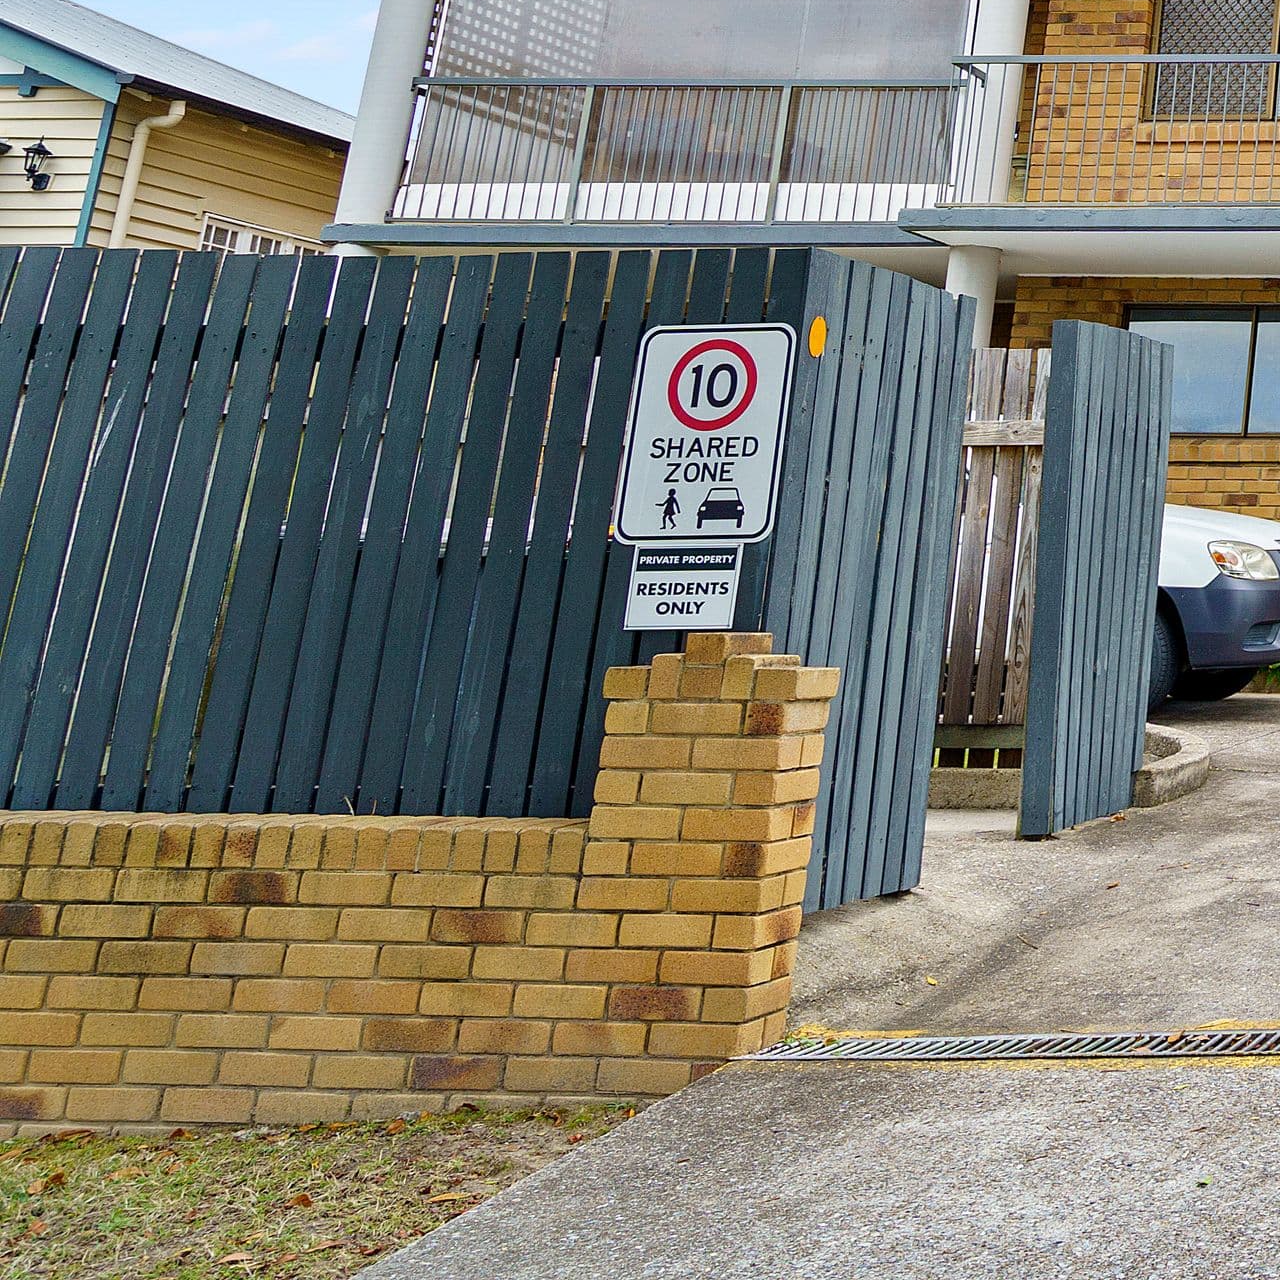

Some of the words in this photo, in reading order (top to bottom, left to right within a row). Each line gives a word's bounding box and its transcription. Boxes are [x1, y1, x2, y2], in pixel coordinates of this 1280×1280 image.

[690, 363, 738, 409] 10
[649, 436, 759, 459] SHARED
[663, 461, 735, 483] ZONE
[639, 555, 680, 565] PRIVATE
[681, 554, 736, 564] PROPERTY
[636, 581, 730, 597] RESIDENTS
[655, 600, 705, 615] ONLY
